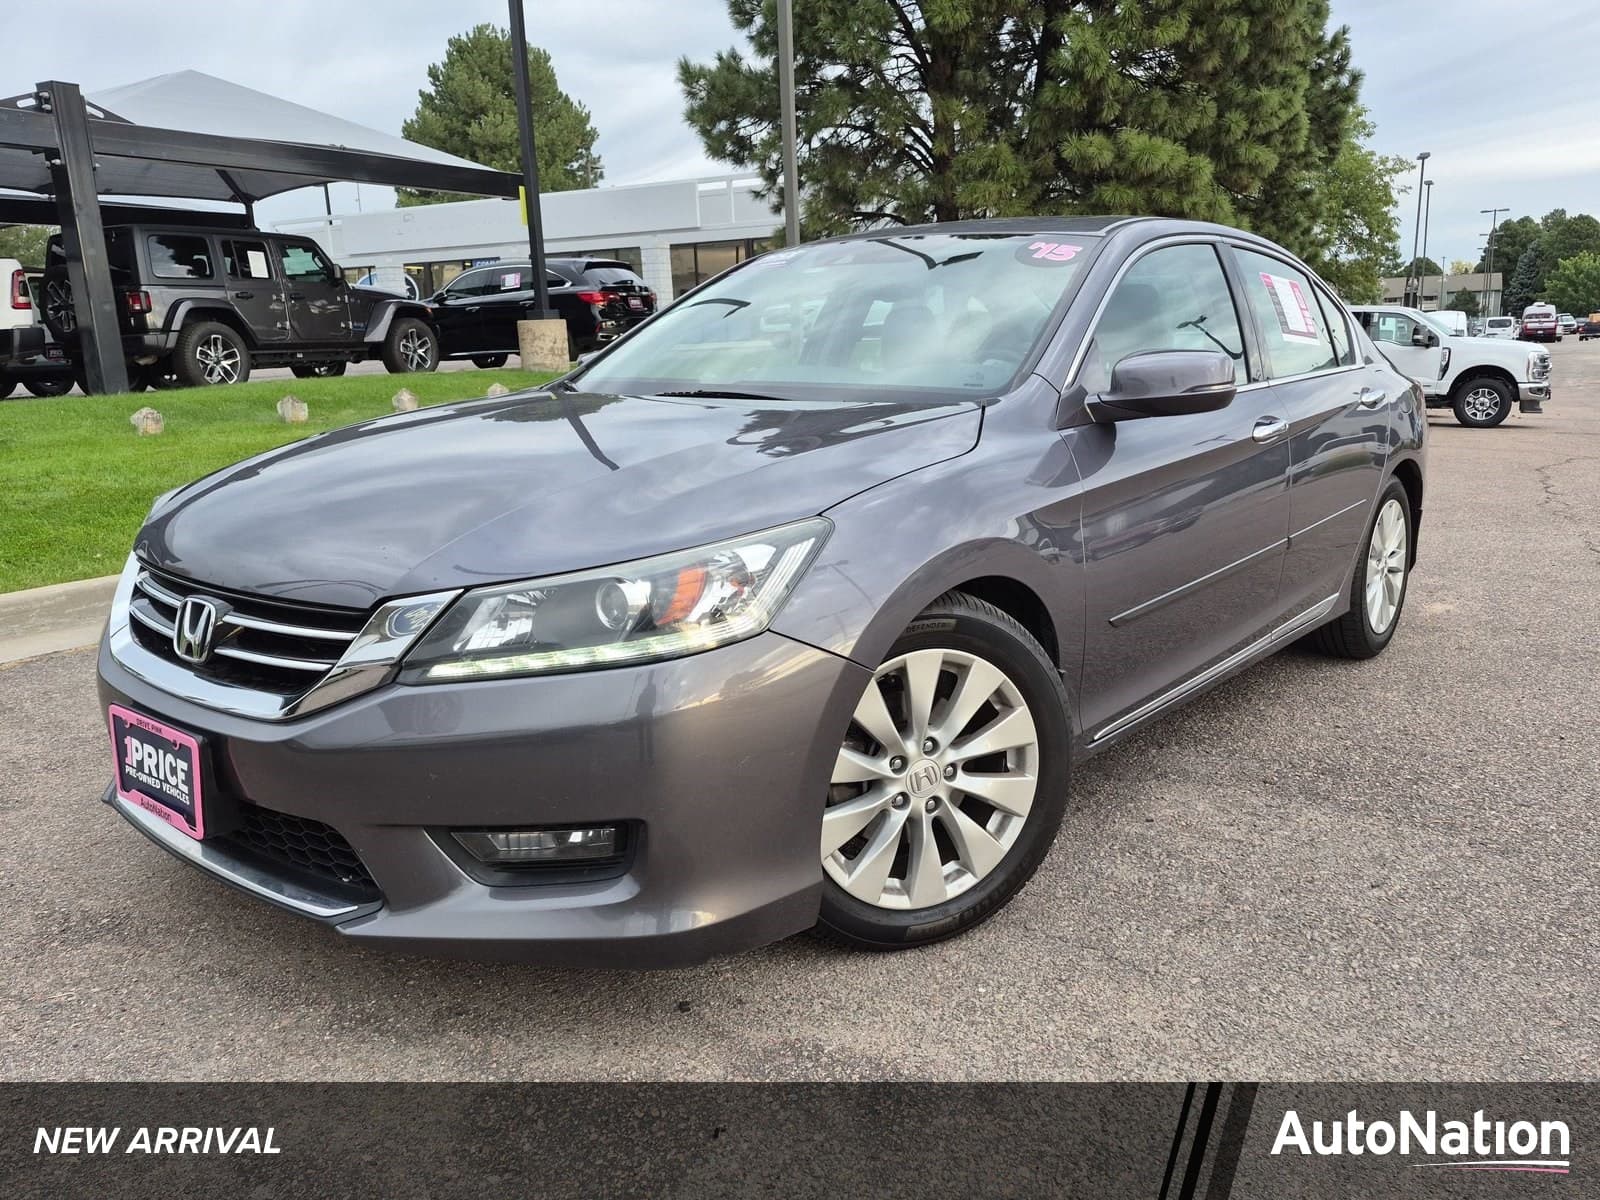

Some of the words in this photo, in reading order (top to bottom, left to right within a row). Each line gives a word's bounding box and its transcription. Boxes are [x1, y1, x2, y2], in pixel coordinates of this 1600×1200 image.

[125, 766, 161, 790] PRE-OWNED
[162, 782, 190, 806] VEHICLES
[140, 798, 172, 823] AutoNation
